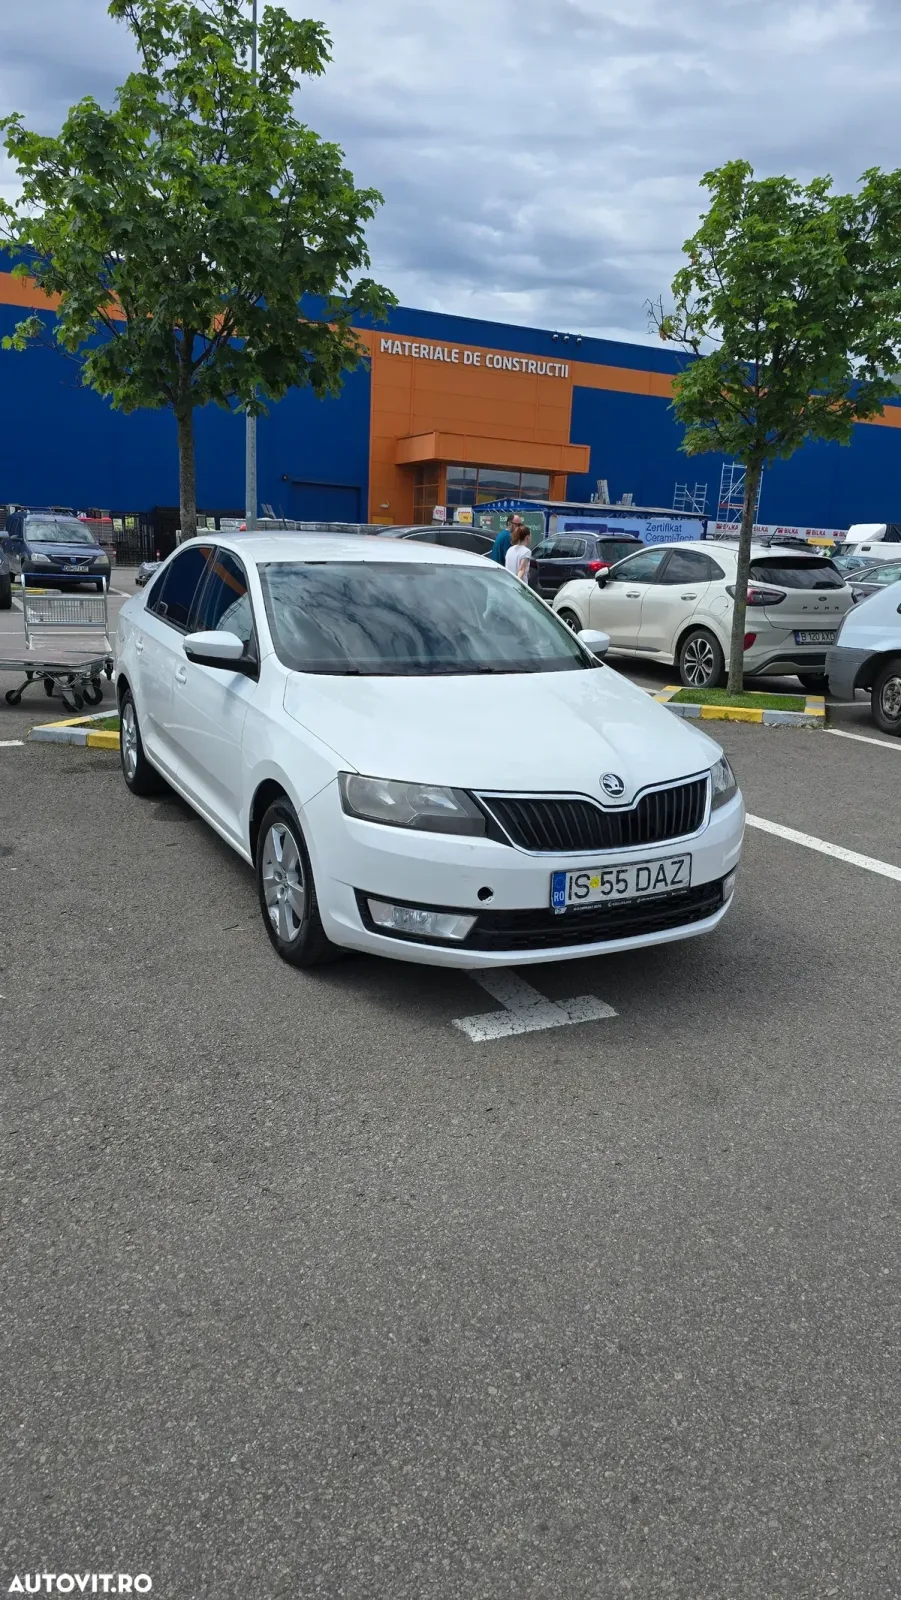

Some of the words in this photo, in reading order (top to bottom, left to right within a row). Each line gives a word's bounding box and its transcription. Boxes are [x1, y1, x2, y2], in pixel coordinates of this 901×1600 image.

[380, 338, 459, 363] MATERIALE
[463, 350, 481, 366] DE
[485, 353, 569, 378] CONSTRUCTII
[646, 522, 682, 533] Zertifikat
[784, 527, 799, 535] BILKA
[800, 632, 807, 641] B
[808, 632, 820, 641] 120
[567, 873, 591, 901] IS
[600, 869, 629, 896] 55
[635, 859, 685, 893] DAZ
[553, 891, 565, 902] RO
